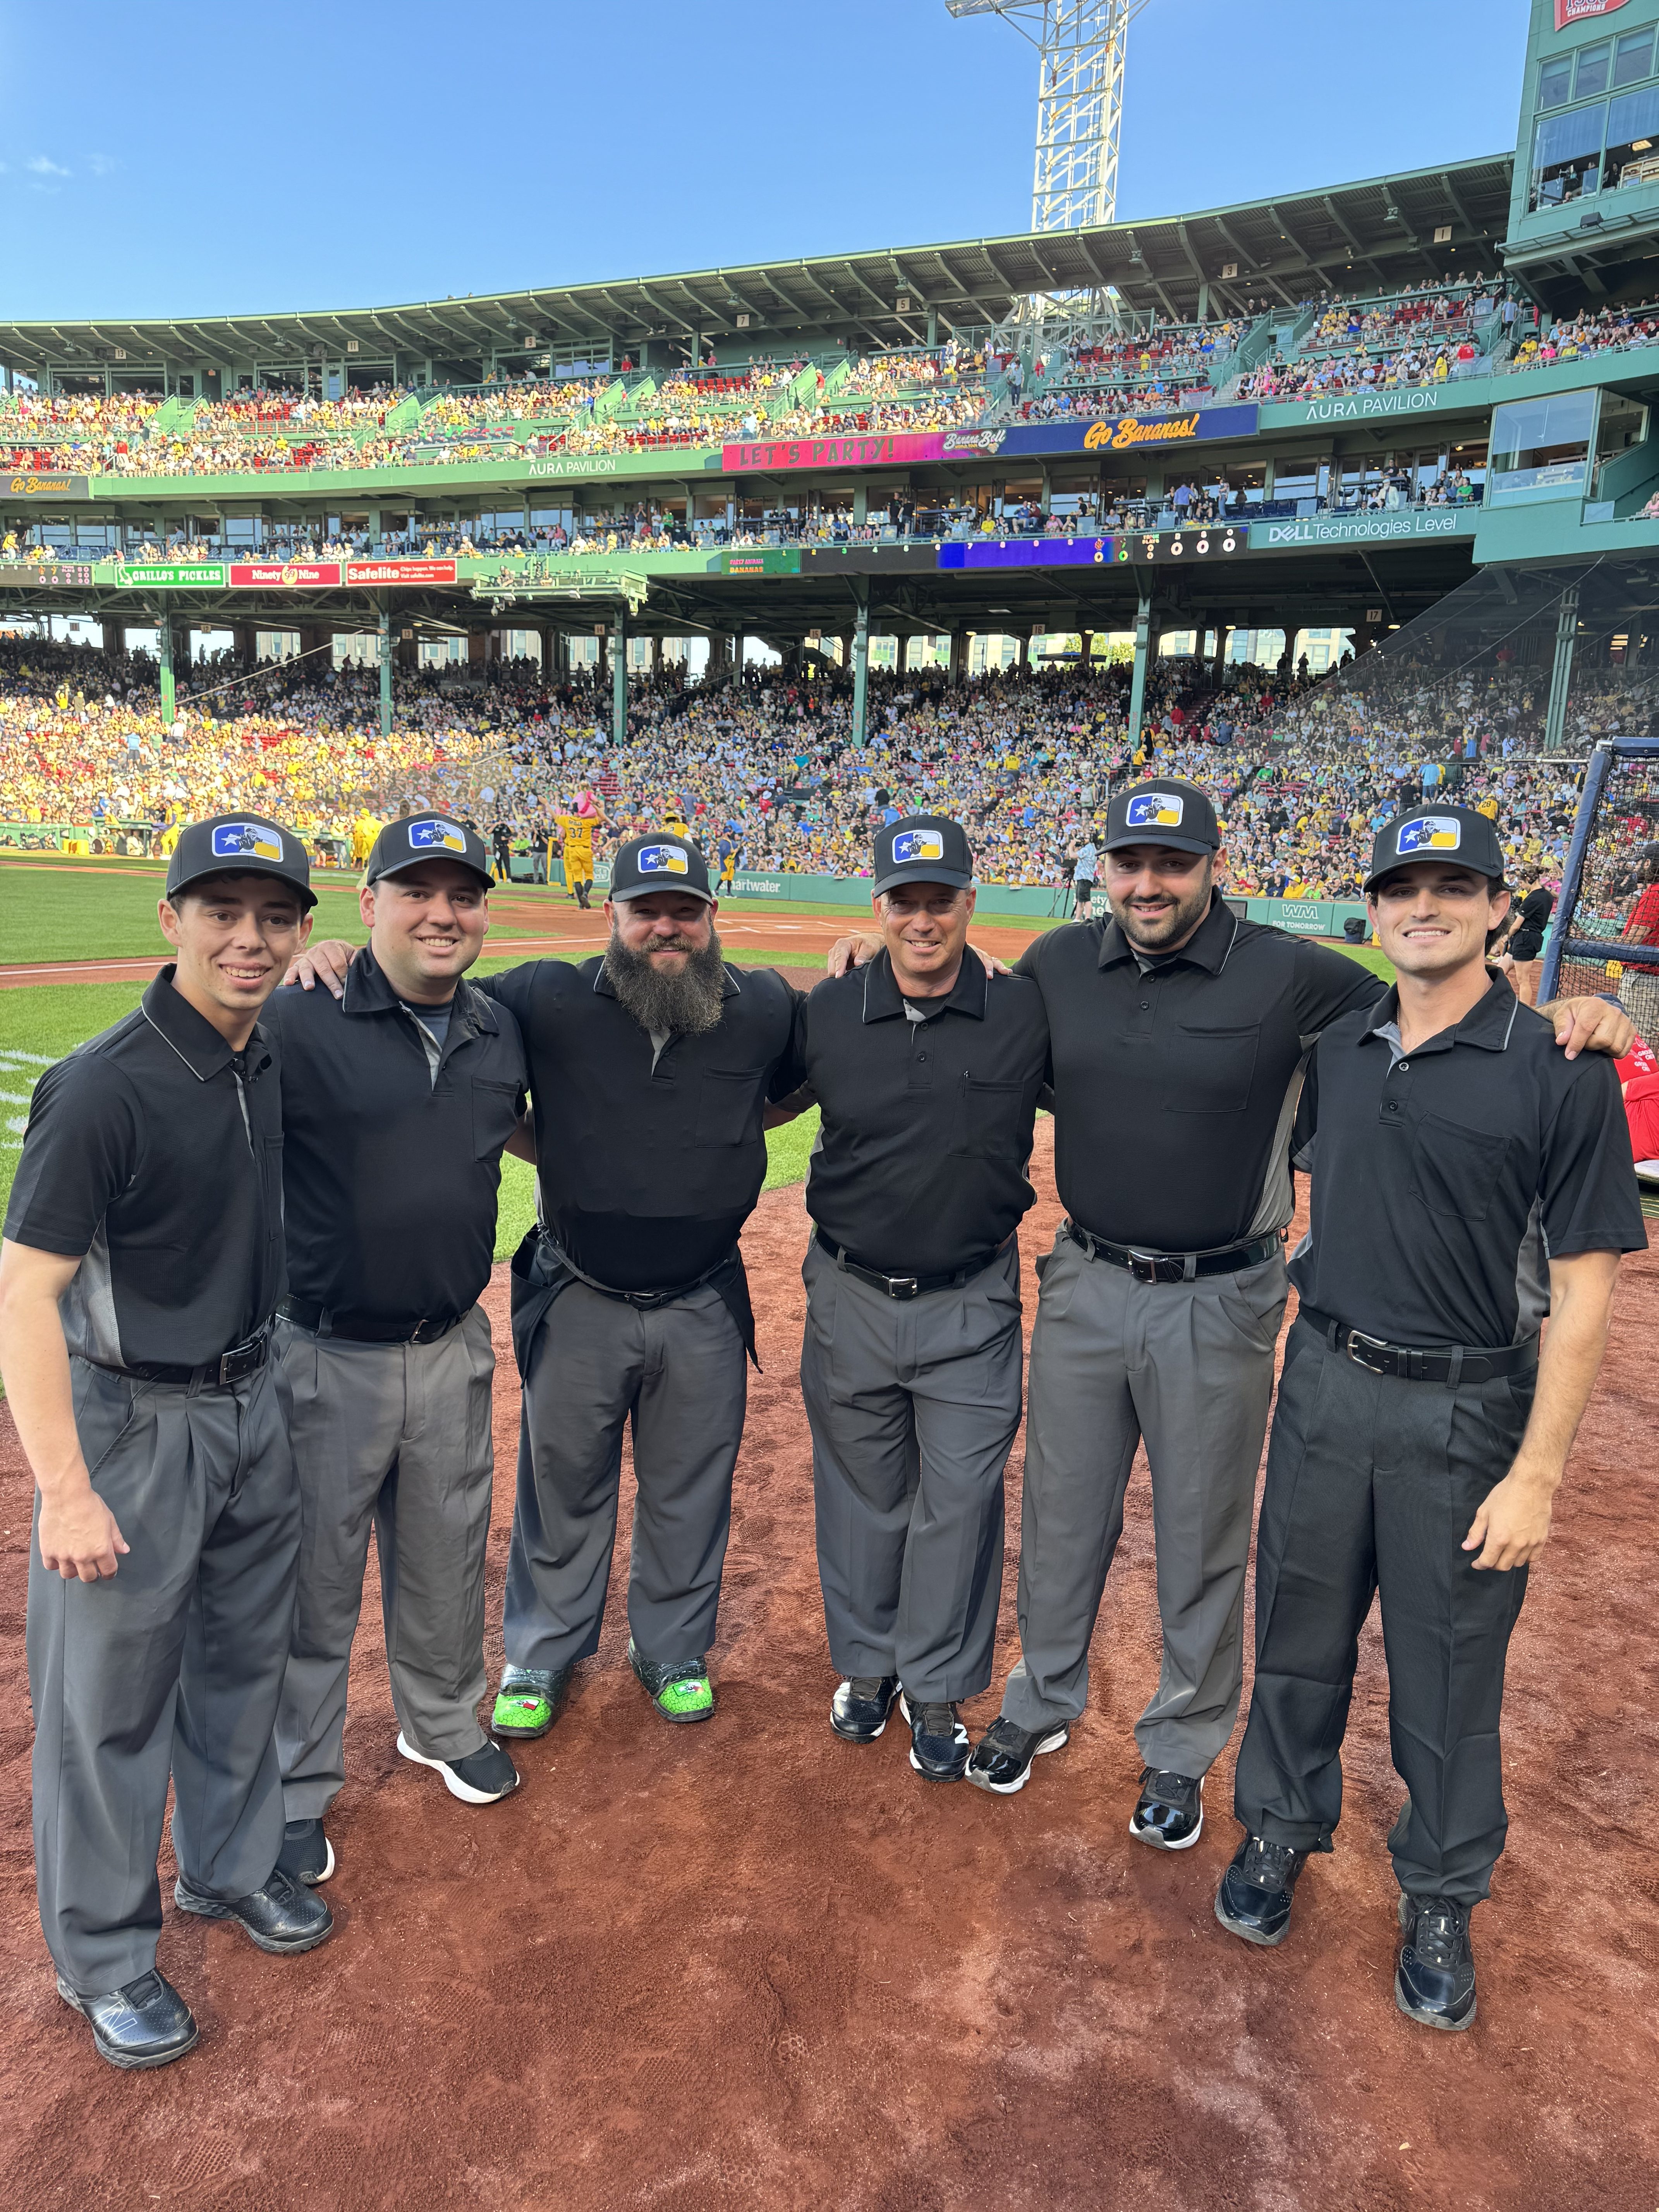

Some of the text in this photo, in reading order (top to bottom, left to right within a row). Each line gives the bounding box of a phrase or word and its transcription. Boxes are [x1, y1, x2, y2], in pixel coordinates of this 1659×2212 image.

[1567, 3, 1606, 17] CHAMPIONS
[1228, 266, 1232, 275] 3
[901, 300, 905, 309] 5
[741, 317, 745, 325] 7
[1363, 392, 1437, 414] PAVILION
[1084, 413, 1200, 449] Go Bananas!
[943, 433, 979, 450] Banana
[740, 438, 894, 465] LET'S PARTY!
[567, 459, 615, 473] PAVILION
[10, 477, 71, 494] Go Bananas!
[1269, 514, 1456, 542] DELL Technologies Level
[1171, 538, 1236, 555] 0 0 0
[132, 570, 221, 581] GRILLO'S PICKLES
[252, 569, 282, 582] Ninety
[298, 569, 319, 579] Nine
[348, 567, 400, 580] Safelite
[1370, 611, 1378, 620] 17
[1035, 625, 1042, 634] 16
[569, 827, 583, 838] 37
[1282, 904, 1318, 919] WM
[1286, 921, 1326, 931] TOMORROW
[91, 2001, 138, 2043] N
